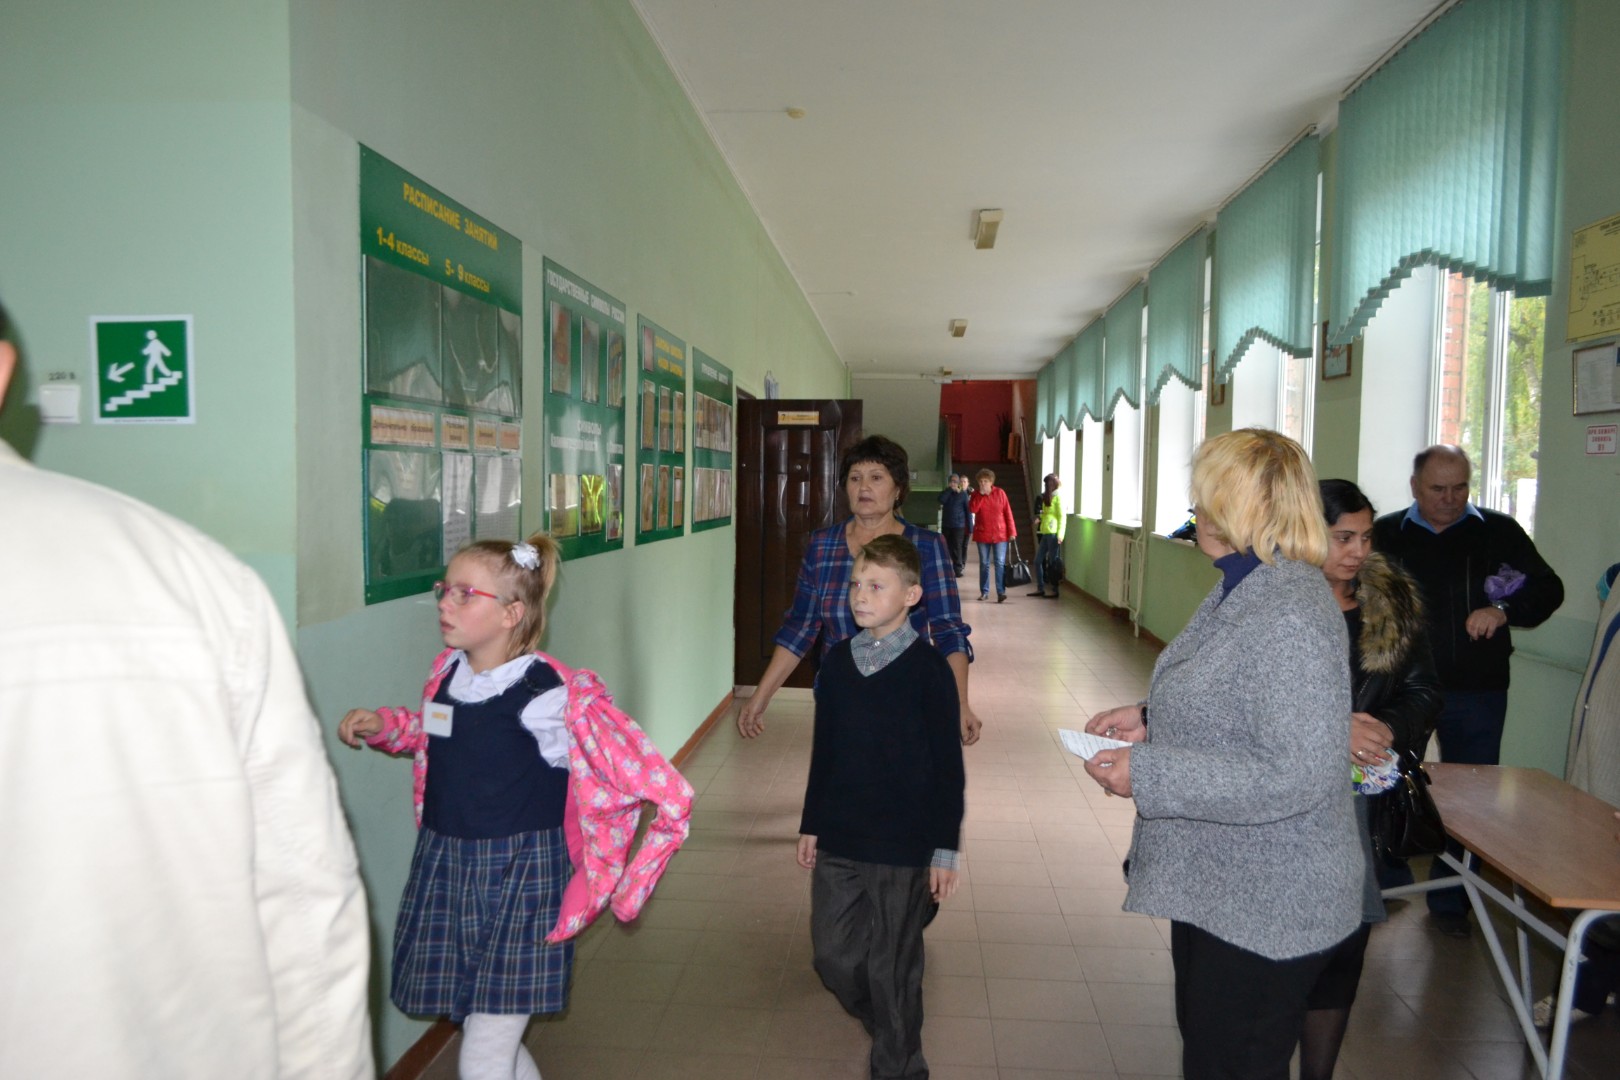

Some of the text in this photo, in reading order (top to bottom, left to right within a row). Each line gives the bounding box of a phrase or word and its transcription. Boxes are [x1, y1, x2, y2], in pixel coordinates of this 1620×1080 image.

[403, 182, 498, 251] РАСПИСАНИЕ ЗАНЯТИЙ
[376, 226, 430, 266] 1-4 классы
